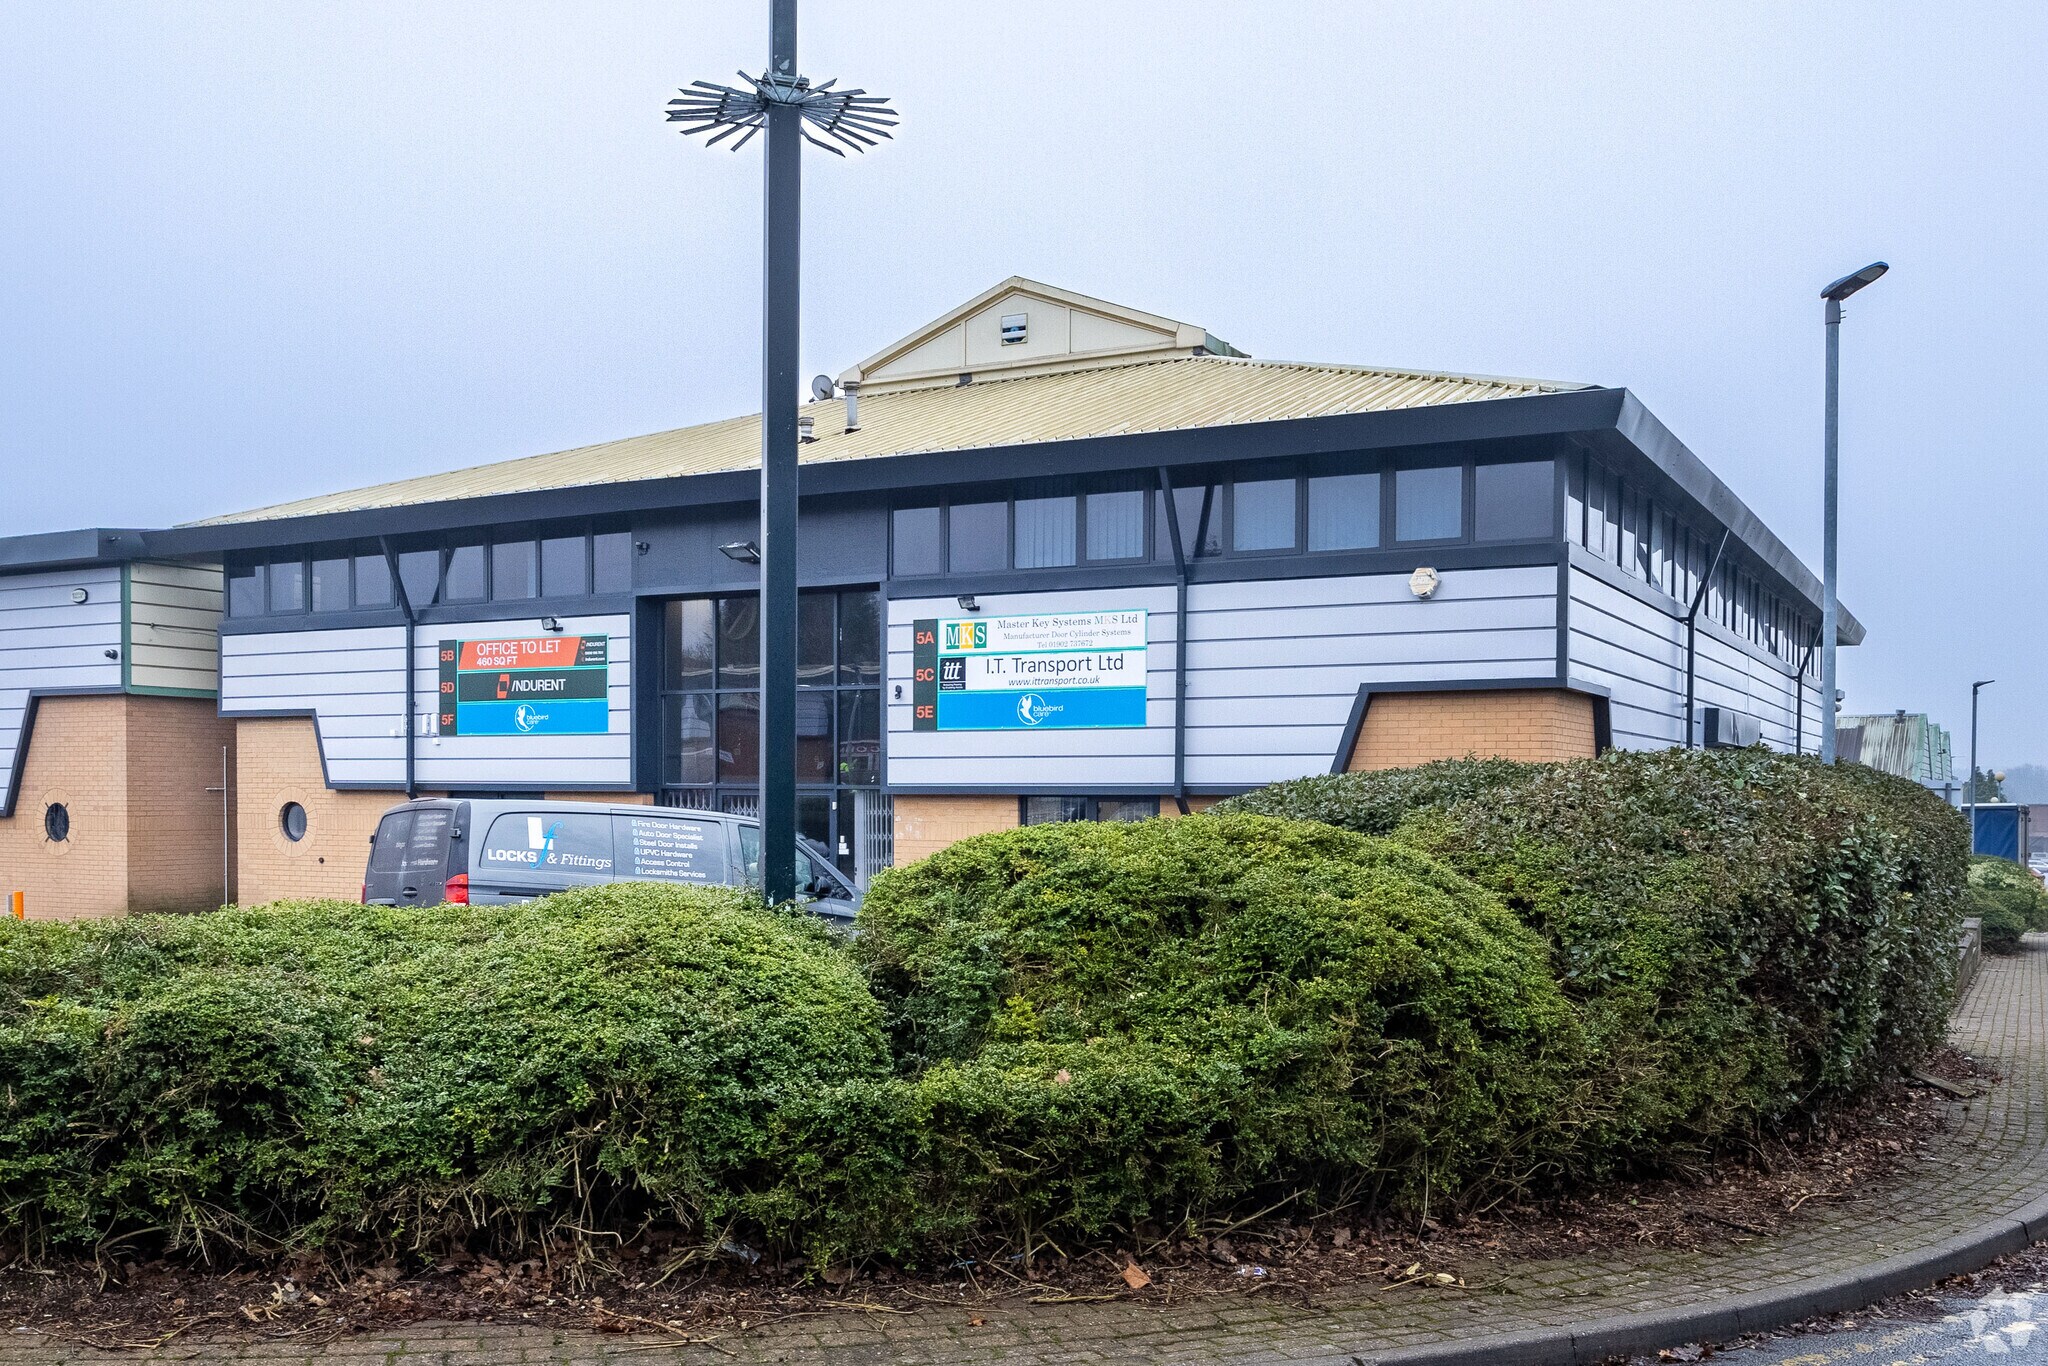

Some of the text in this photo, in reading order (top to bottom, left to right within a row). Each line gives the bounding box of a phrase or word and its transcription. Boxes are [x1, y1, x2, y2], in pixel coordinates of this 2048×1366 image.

[997, 620, 1029, 629] Master
[1032, 618, 1050, 629] Key
[1052, 618, 1091, 627] Systems
[1121, 614, 1138, 624] Ltd
[916, 632, 934, 644] 5A
[946, 624, 986, 647] MKS
[1003, 632, 1050, 640] Manufacturer
[1070, 630, 1099, 639] Cylinder
[1101, 629, 1131, 637] Systems
[476, 640, 561, 656] OFFICE TO LET
[440, 650, 454, 662] 5B
[476, 656, 518, 666] 460 SQ FT
[986, 653, 1124, 676] I.T. Transport Ltd
[916, 668, 934, 681] 5C
[943, 662, 962, 680] itt
[1008, 676, 1100, 686] www.ittransport.co.uk
[440, 682, 454, 694] 5D
[916, 706, 934, 719] 5E
[441, 714, 454, 726] 5F
[669, 823, 701, 832] Hardware
[673, 832, 704, 841] Specialist
[658, 840, 674, 848] Door
[487, 848, 612, 870] LOCKS & Fittings
[661, 850, 693, 858] Hardware
[641, 858, 690, 868] Access Control
[641, 868, 706, 878] Locksmiths Services
